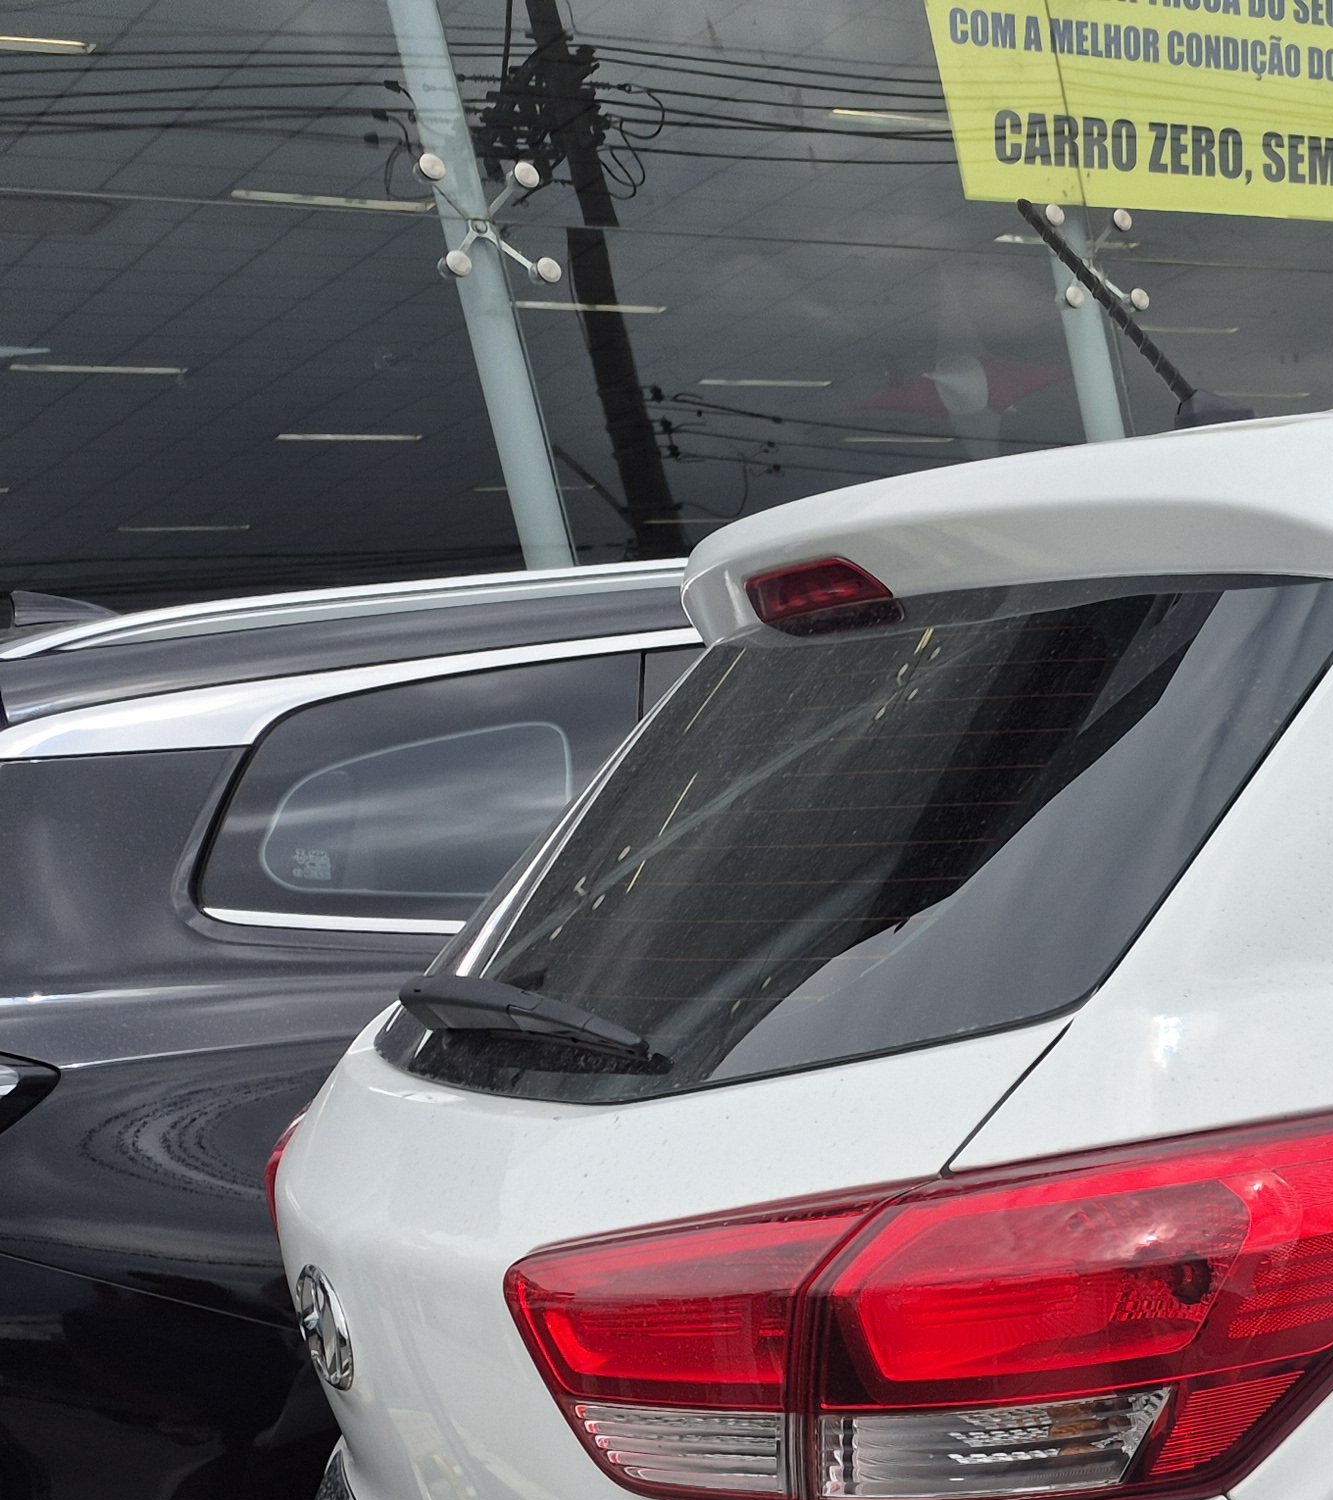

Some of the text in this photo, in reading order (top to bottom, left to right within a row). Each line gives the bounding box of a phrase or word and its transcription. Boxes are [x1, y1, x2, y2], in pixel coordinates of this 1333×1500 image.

[949, 8, 1016, 49] COM
[1023, 16, 1043, 52] A
[1050, 18, 1160, 63] MELHOR
[1167, 30, 1301, 81] CONDIÇÃO
[994, 109, 1138, 172] CARRO
[1148, 122, 1252, 185] ZERO,
